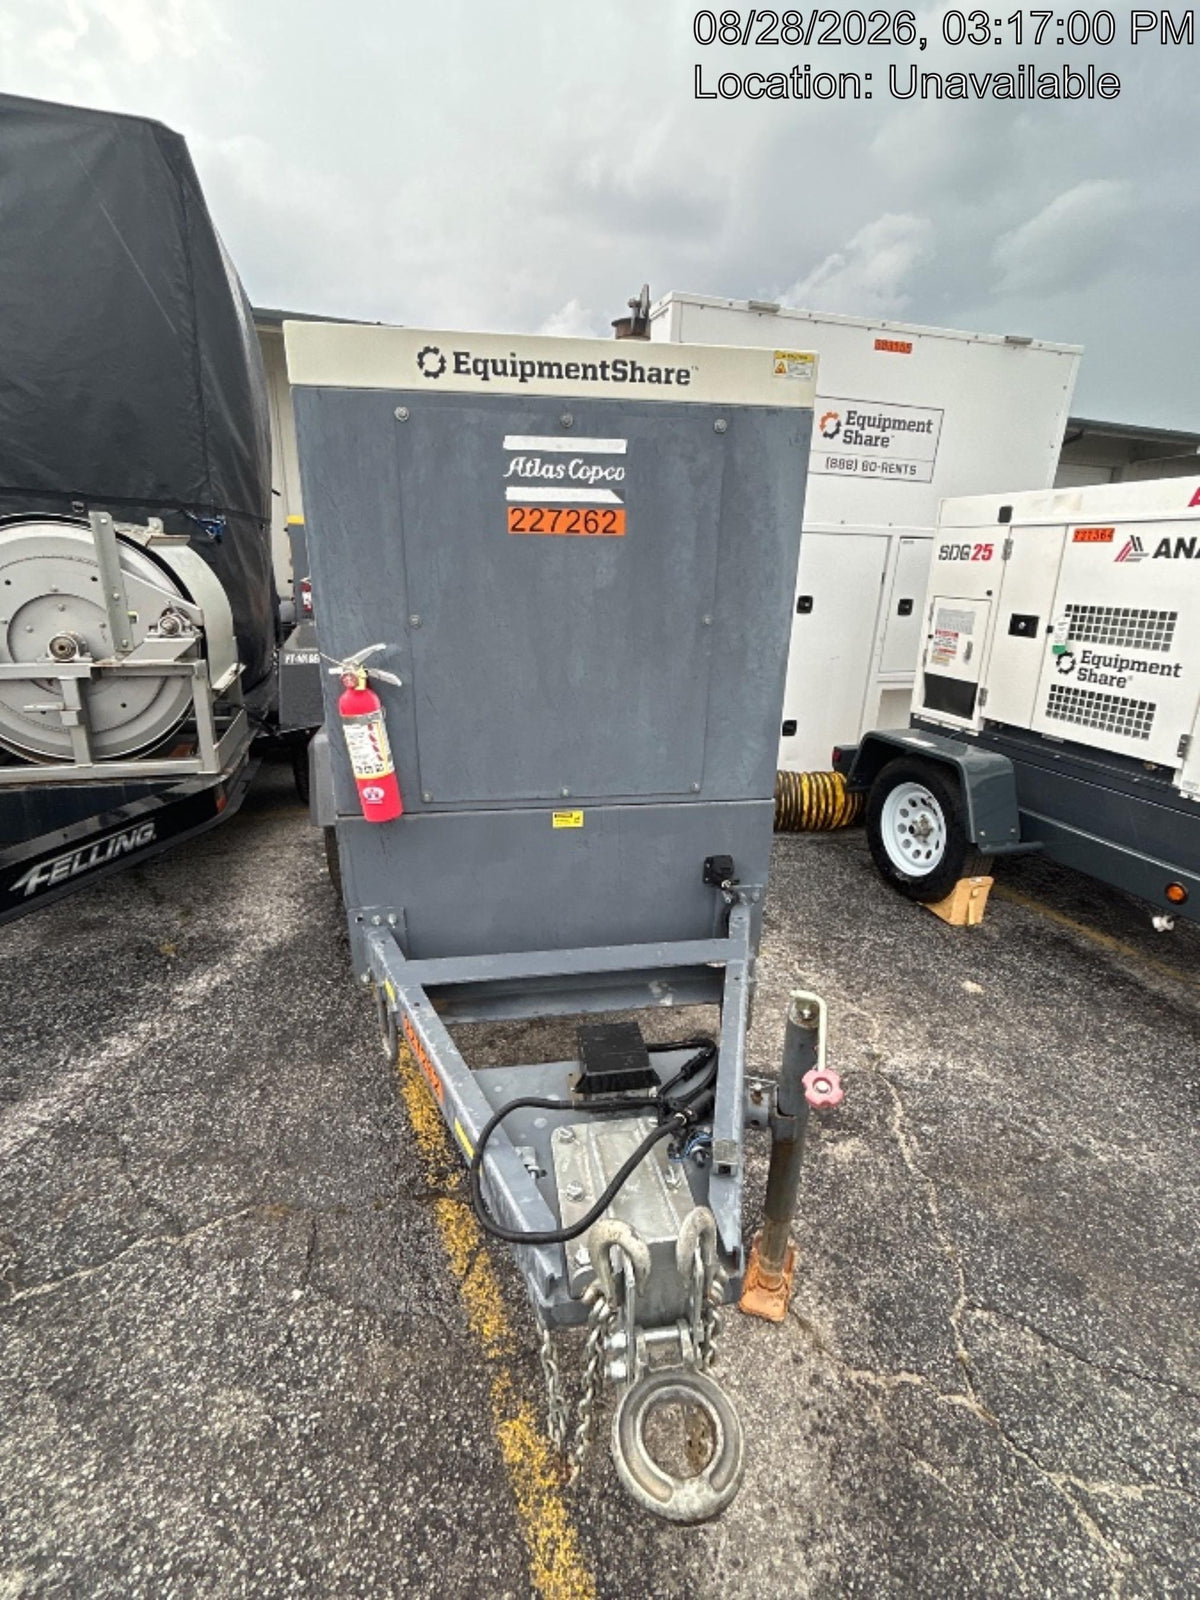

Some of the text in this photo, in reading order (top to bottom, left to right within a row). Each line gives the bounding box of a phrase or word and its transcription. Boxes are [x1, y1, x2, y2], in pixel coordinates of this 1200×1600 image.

[452, 350, 691, 386] EquipmentShare
[845, 410, 934, 434] Equipment
[842, 429, 890, 449] Share
[503, 456, 625, 484] Atlas Copco
[510, 507, 617, 534] 227262
[1080, 649, 1183, 678] Equipment
[1077, 667, 1127, 689] Share
[8, 822, 156, 896] FELLING
